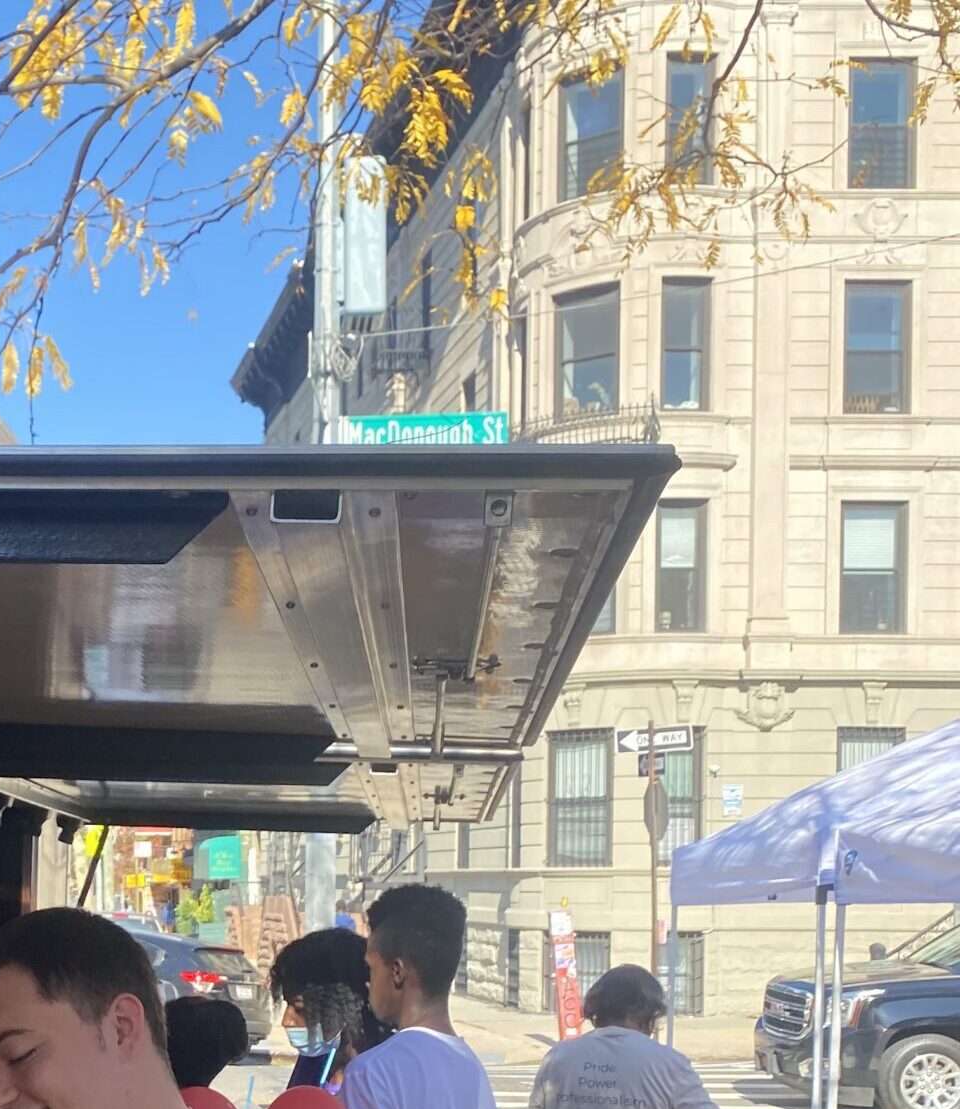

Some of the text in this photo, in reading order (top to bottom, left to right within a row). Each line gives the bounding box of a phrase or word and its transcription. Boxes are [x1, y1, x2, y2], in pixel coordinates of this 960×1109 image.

[349, 416, 504, 444] MacDonough St
[661, 733, 683, 743] WAY
[583, 1062, 616, 1074] Pride
[578, 1078, 617, 1089] Power
[556, 1092, 648, 1108] rofessionalism
